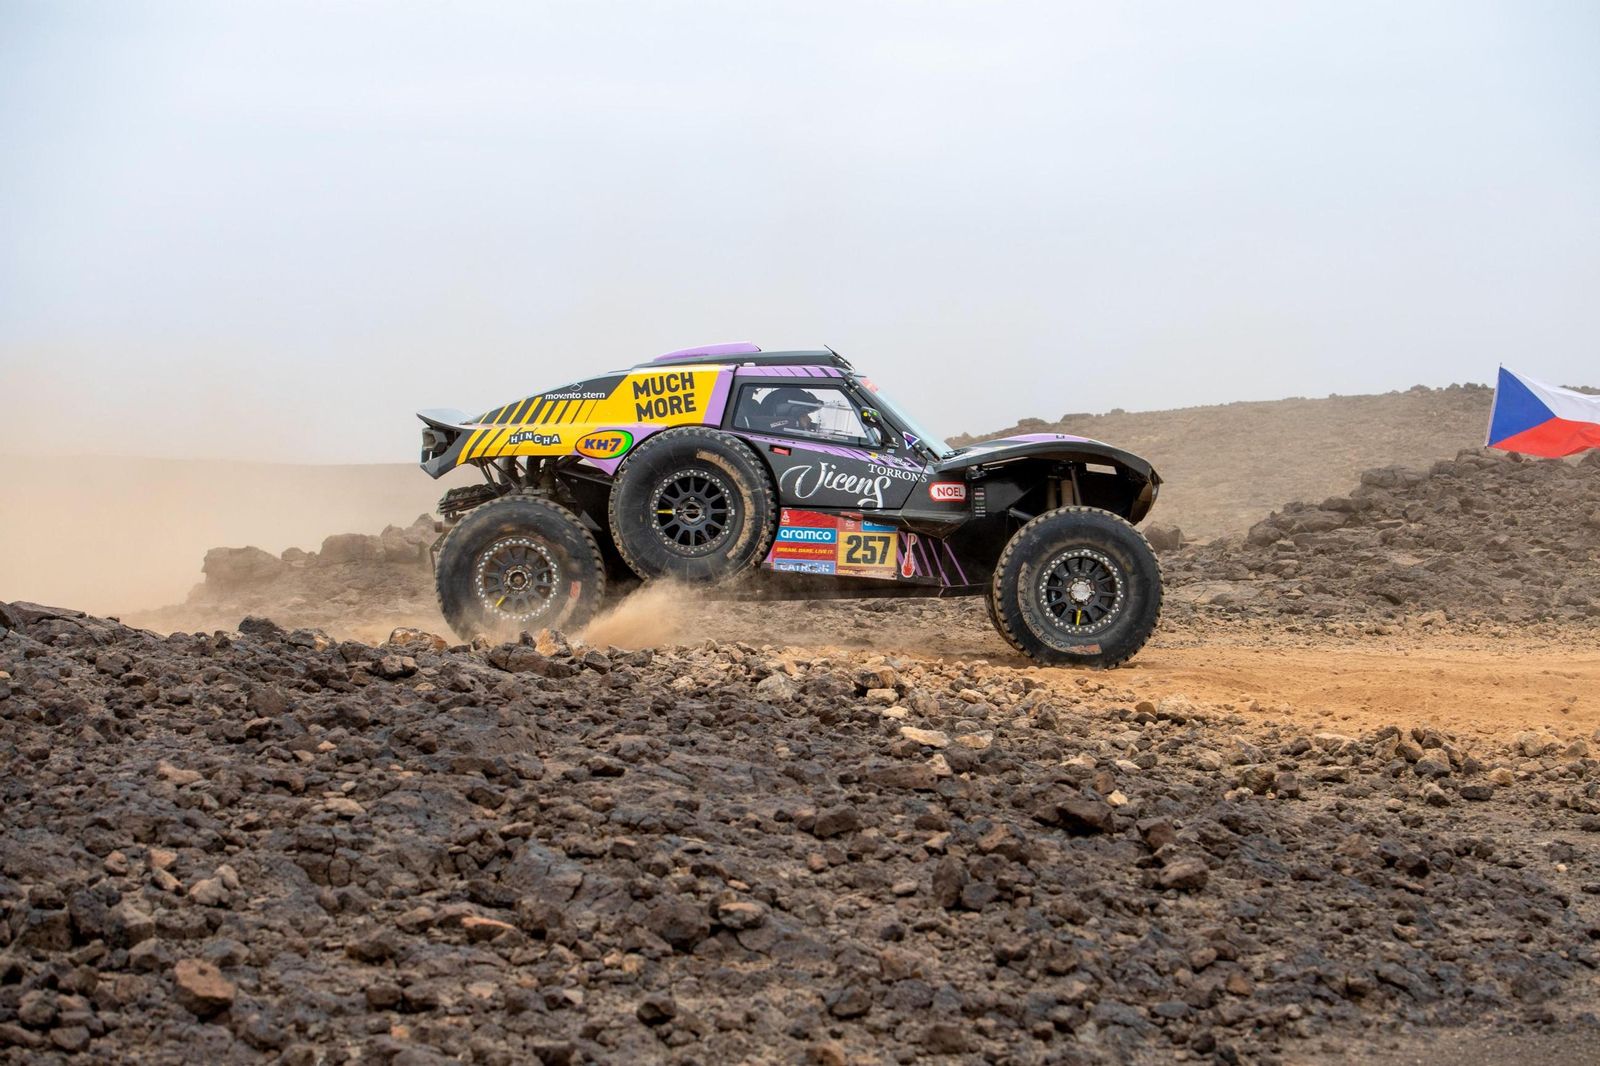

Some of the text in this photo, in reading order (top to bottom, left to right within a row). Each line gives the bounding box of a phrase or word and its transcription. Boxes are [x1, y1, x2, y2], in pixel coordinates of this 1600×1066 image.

[633, 372, 695, 399] MUCH
[582, 391, 606, 399] stern
[636, 393, 696, 422] MORE
[509, 431, 561, 446] HINCHA
[868, 463, 928, 483] TORRONS
[937, 487, 963, 497] NOEL
[780, 529, 832, 540] aramco
[846, 535, 891, 565] 257
